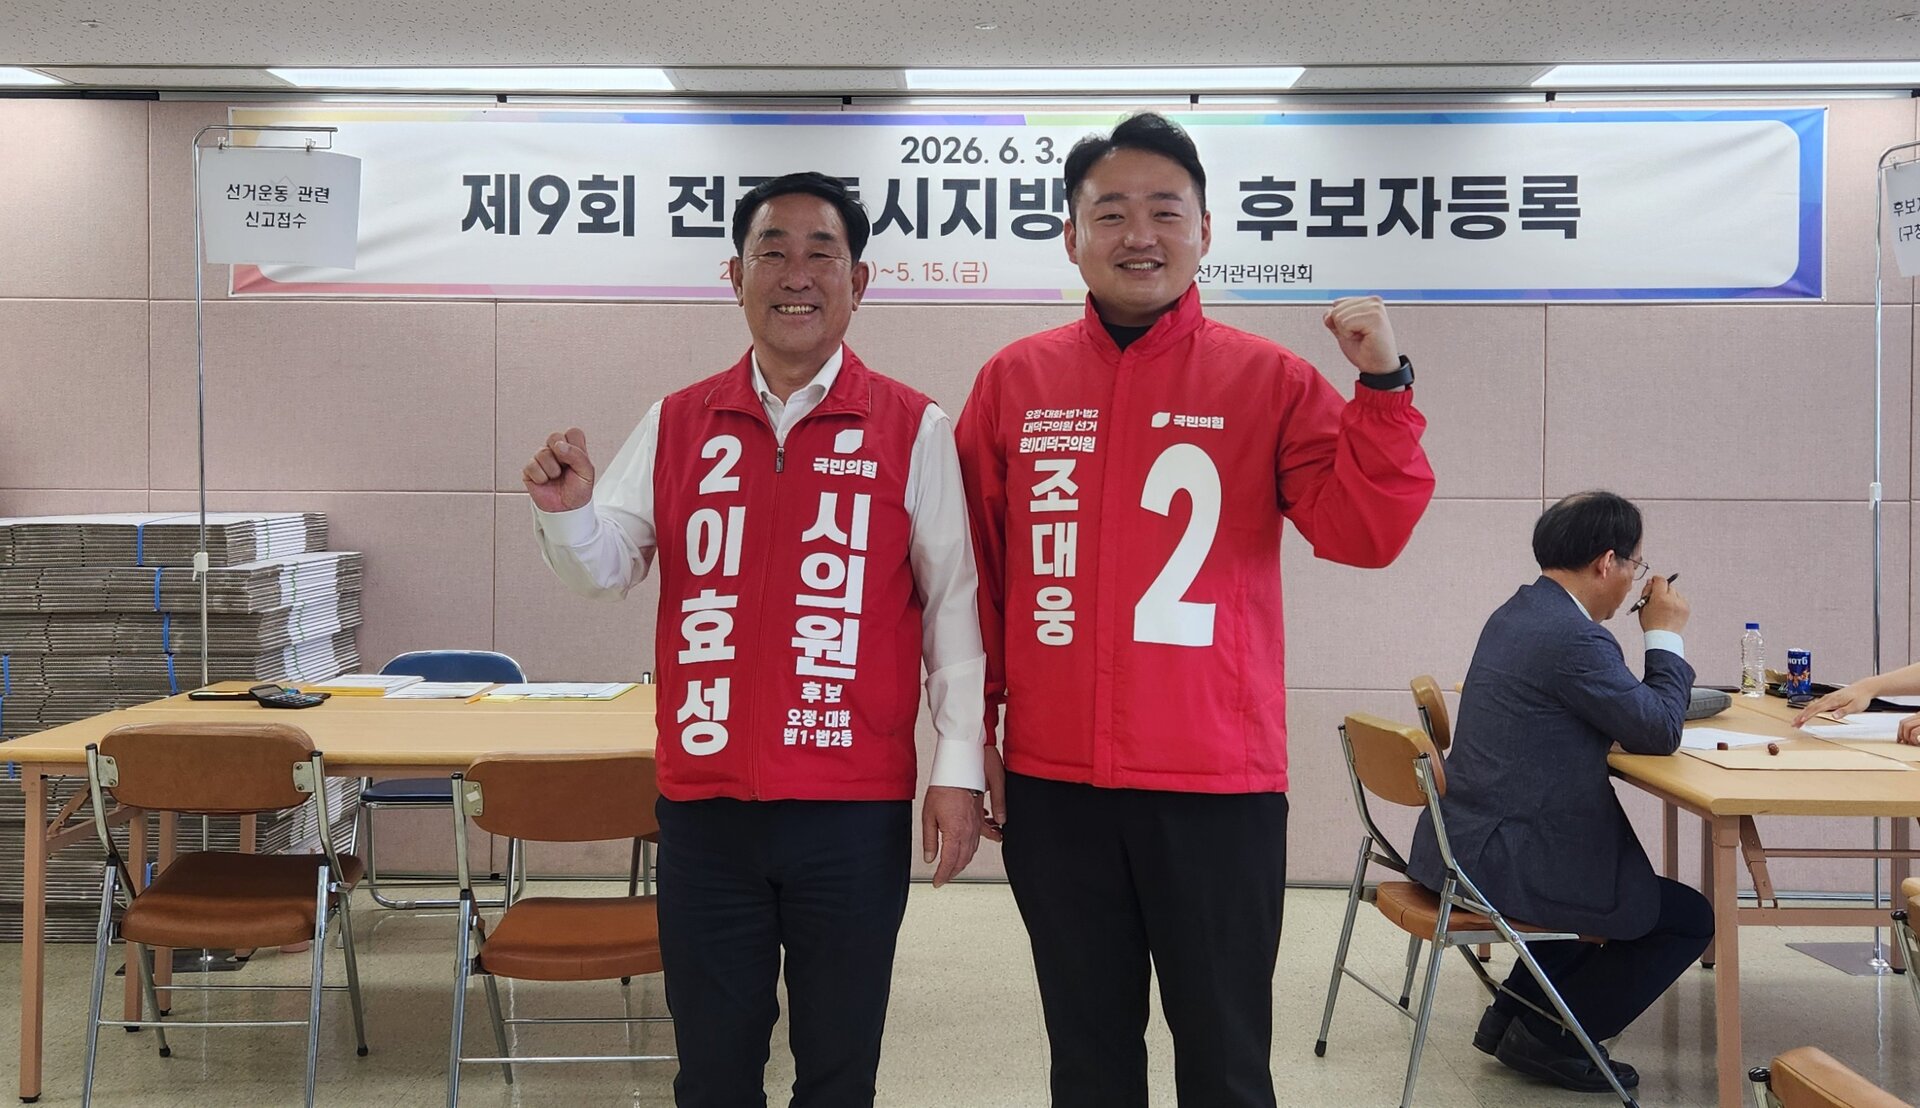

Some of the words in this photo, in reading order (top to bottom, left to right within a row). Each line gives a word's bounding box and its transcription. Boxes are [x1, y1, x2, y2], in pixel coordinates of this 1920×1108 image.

[900, 136, 989, 165] 2026.
[999, 136, 1025, 164] 6.
[1035, 136, 1063, 164] 3.
[226, 183, 289, 203] 선거운동
[297, 185, 330, 204] 관련
[461, 173, 636, 237] 제9회
[667, 175, 1067, 241] 전시지방
[1236, 175, 1582, 241] 후보자등록
[1893, 198, 1920, 217] 후보
[245, 211, 307, 229] 신고접수
[922, 261, 989, 284] 15.(금)
[1022, 420, 1074, 433] 대덕구의원
[1075, 420, 1098, 432] 선거
[1173, 414, 1225, 430] 국민의힘
[1019, 435, 1096, 454] 현)대덕구의원
[698, 434, 743, 496] 2
[812, 457, 878, 480] 국민의힘
[1029, 458, 1080, 646] 조대웅
[1133, 442, 1222, 647] 2
[791, 491, 871, 680] 시의원
[676, 505, 747, 757] 이효성
[800, 681, 843, 704] 후보
[787, 708, 851, 728] 오정·대화
[783, 728, 853, 748] 법1·법2동
